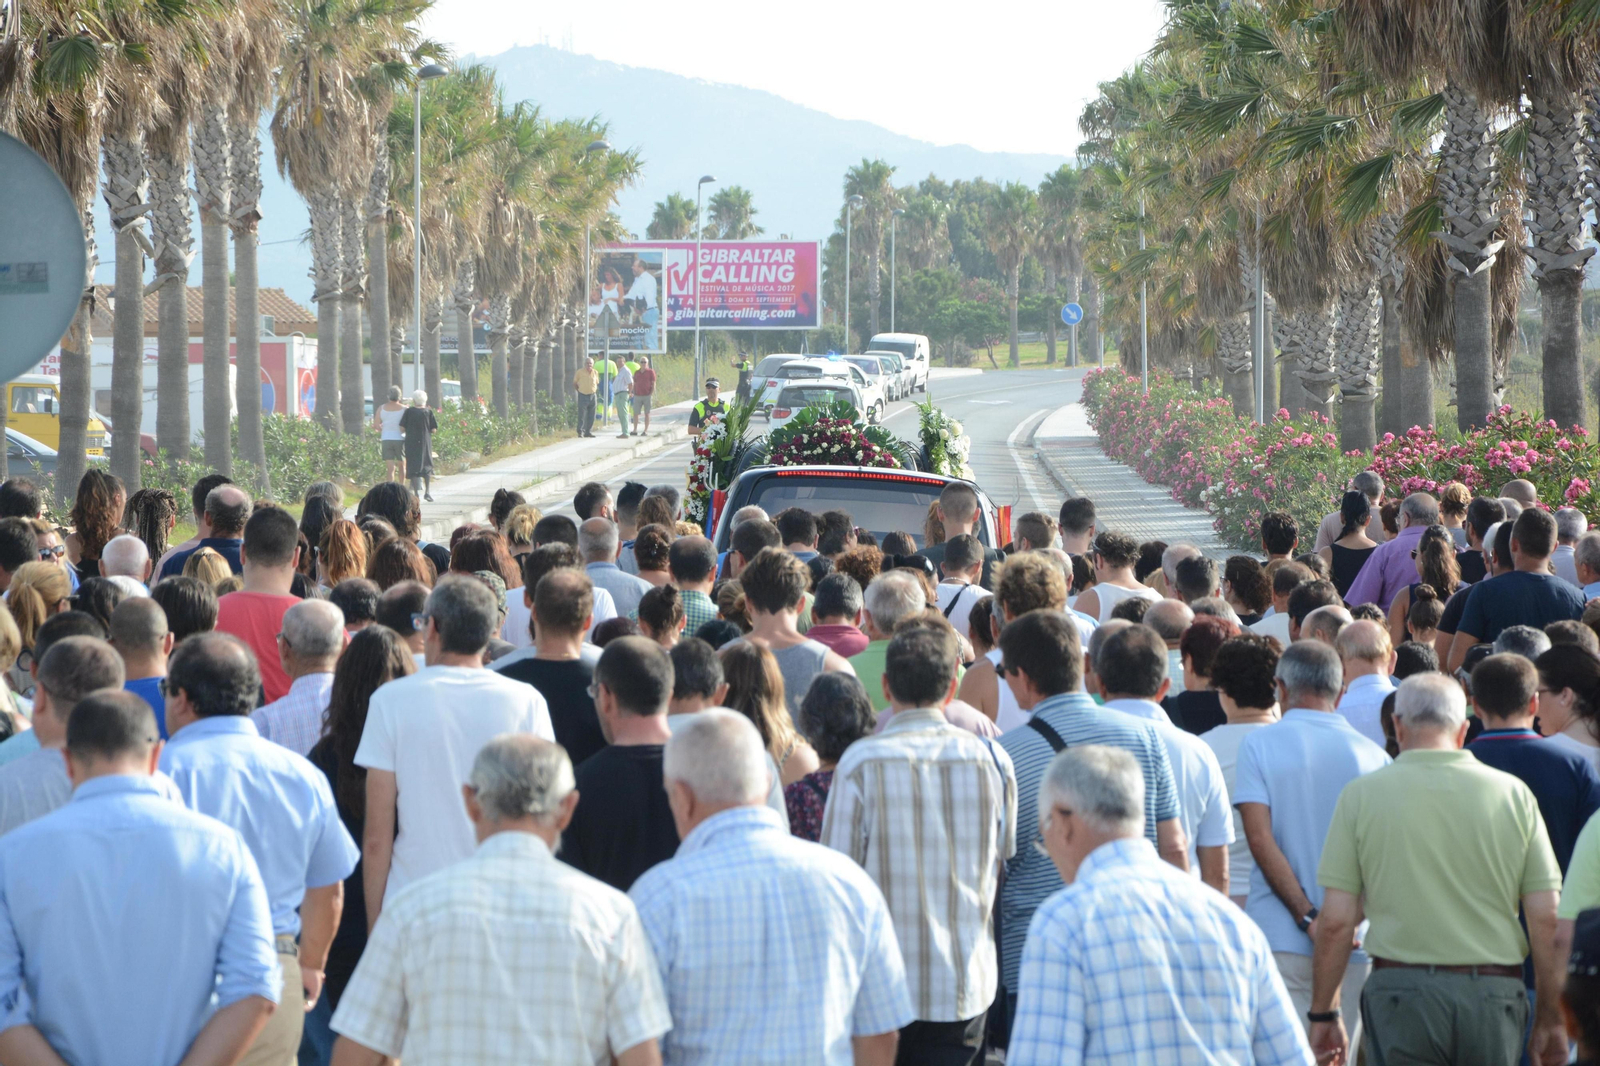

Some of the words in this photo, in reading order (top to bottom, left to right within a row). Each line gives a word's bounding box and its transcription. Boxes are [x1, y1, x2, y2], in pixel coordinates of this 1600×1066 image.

[700, 248, 796, 264] GIBRALTAR
[700, 264, 795, 283] CALLING
[744, 284, 774, 292] MÚSICA
